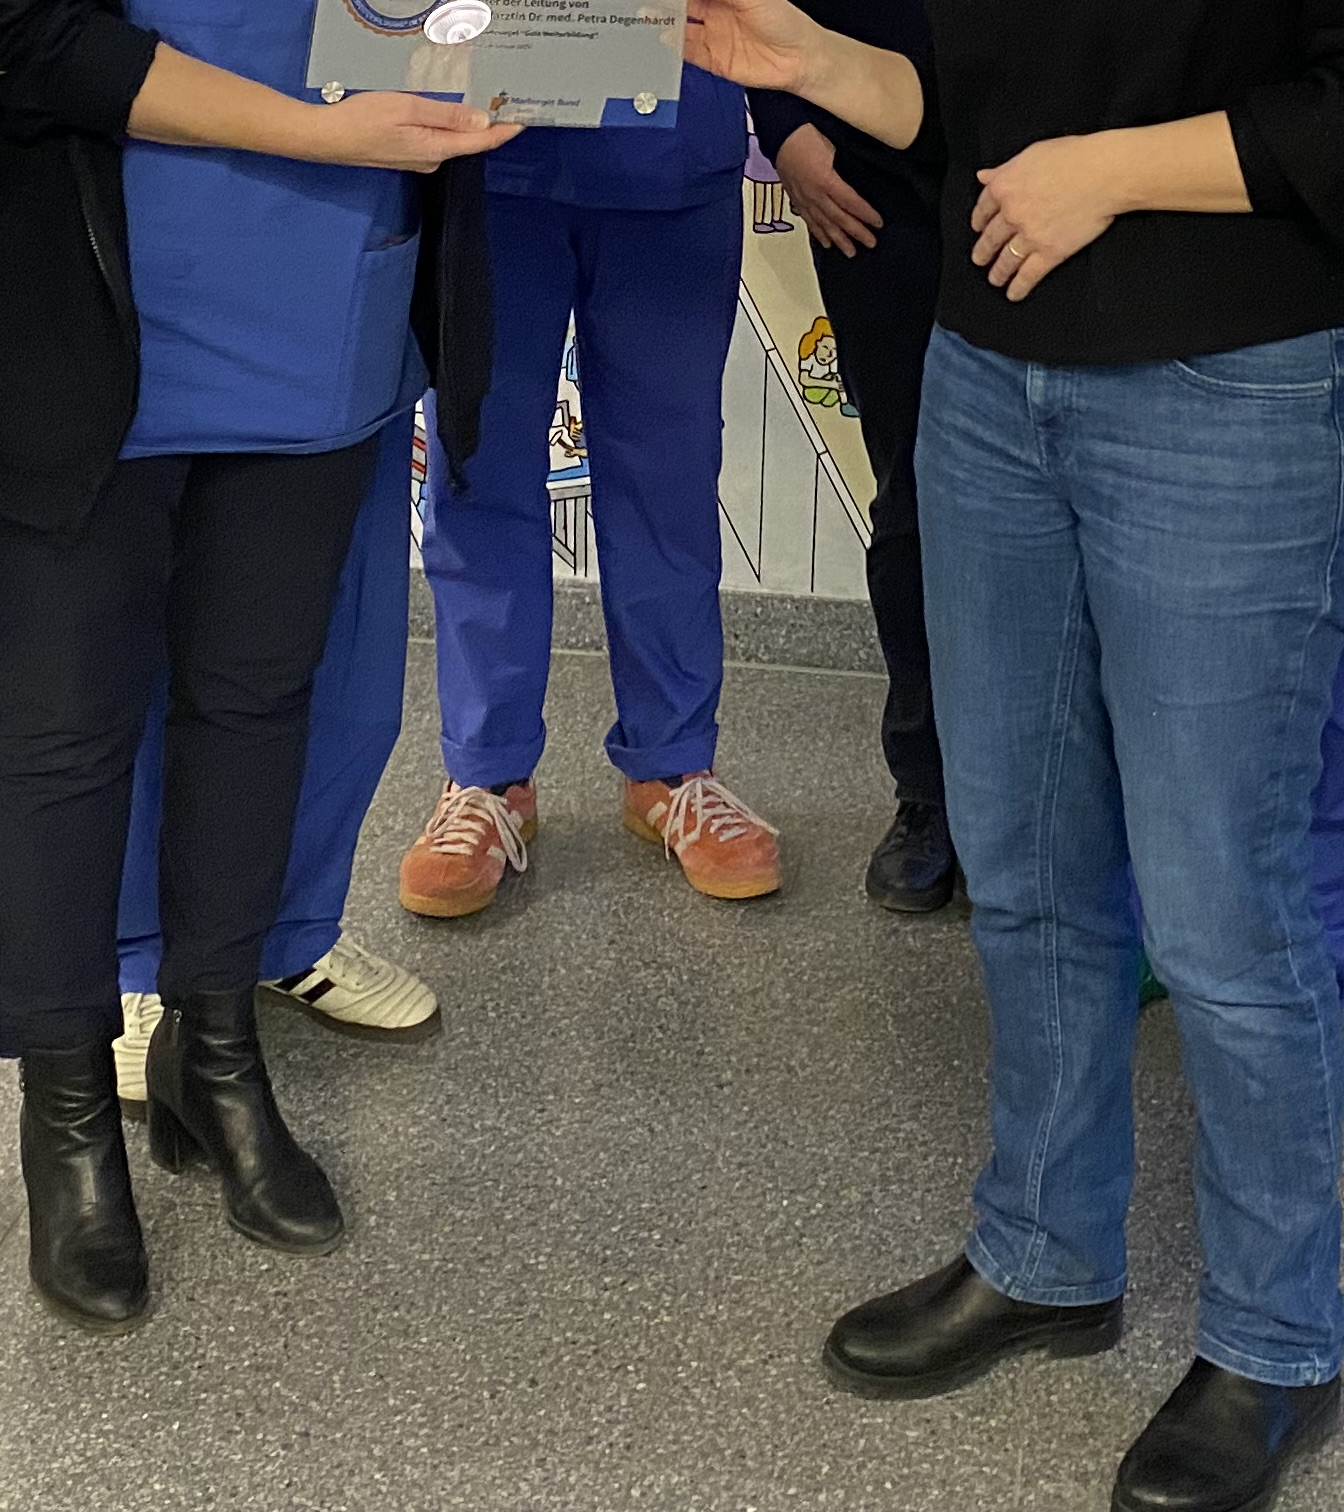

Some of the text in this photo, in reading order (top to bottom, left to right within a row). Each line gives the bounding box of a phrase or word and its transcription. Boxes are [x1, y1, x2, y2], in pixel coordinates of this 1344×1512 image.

[568, 1, 590, 9] von
[546, 13, 575, 22] med.
[577, 13, 607, 24] Petra
[609, 14, 676, 27] Degenhardt
